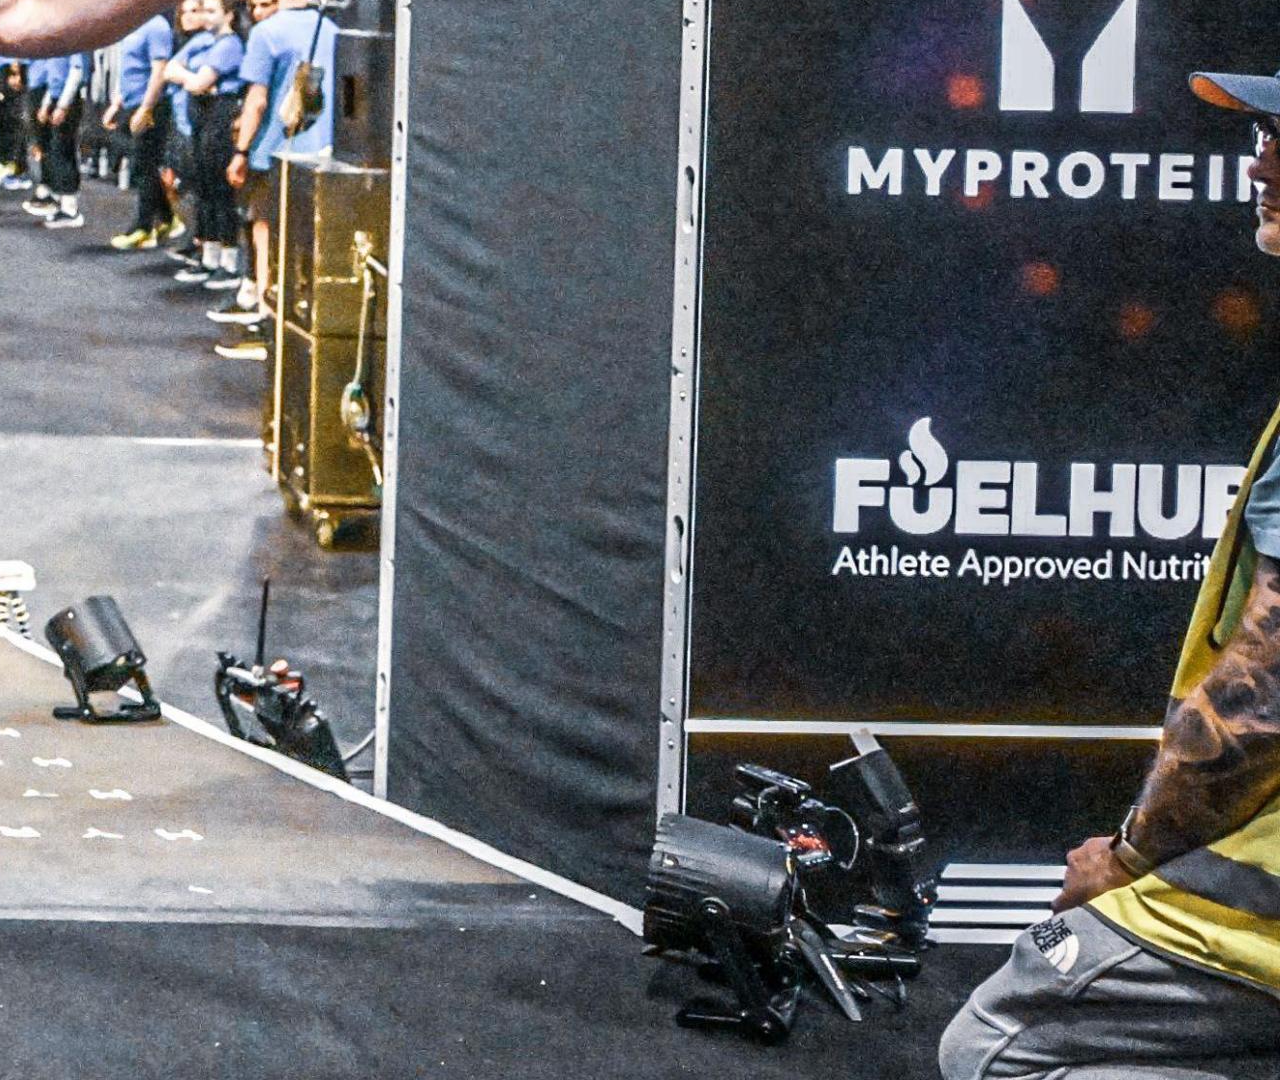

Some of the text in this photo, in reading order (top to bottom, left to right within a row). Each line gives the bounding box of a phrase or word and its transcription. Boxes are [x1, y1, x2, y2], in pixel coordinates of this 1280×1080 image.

[831, 544, 951, 578] Athlete
[957, 546, 1113, 587] Approved
[1039, 919, 1064, 948] RTH
